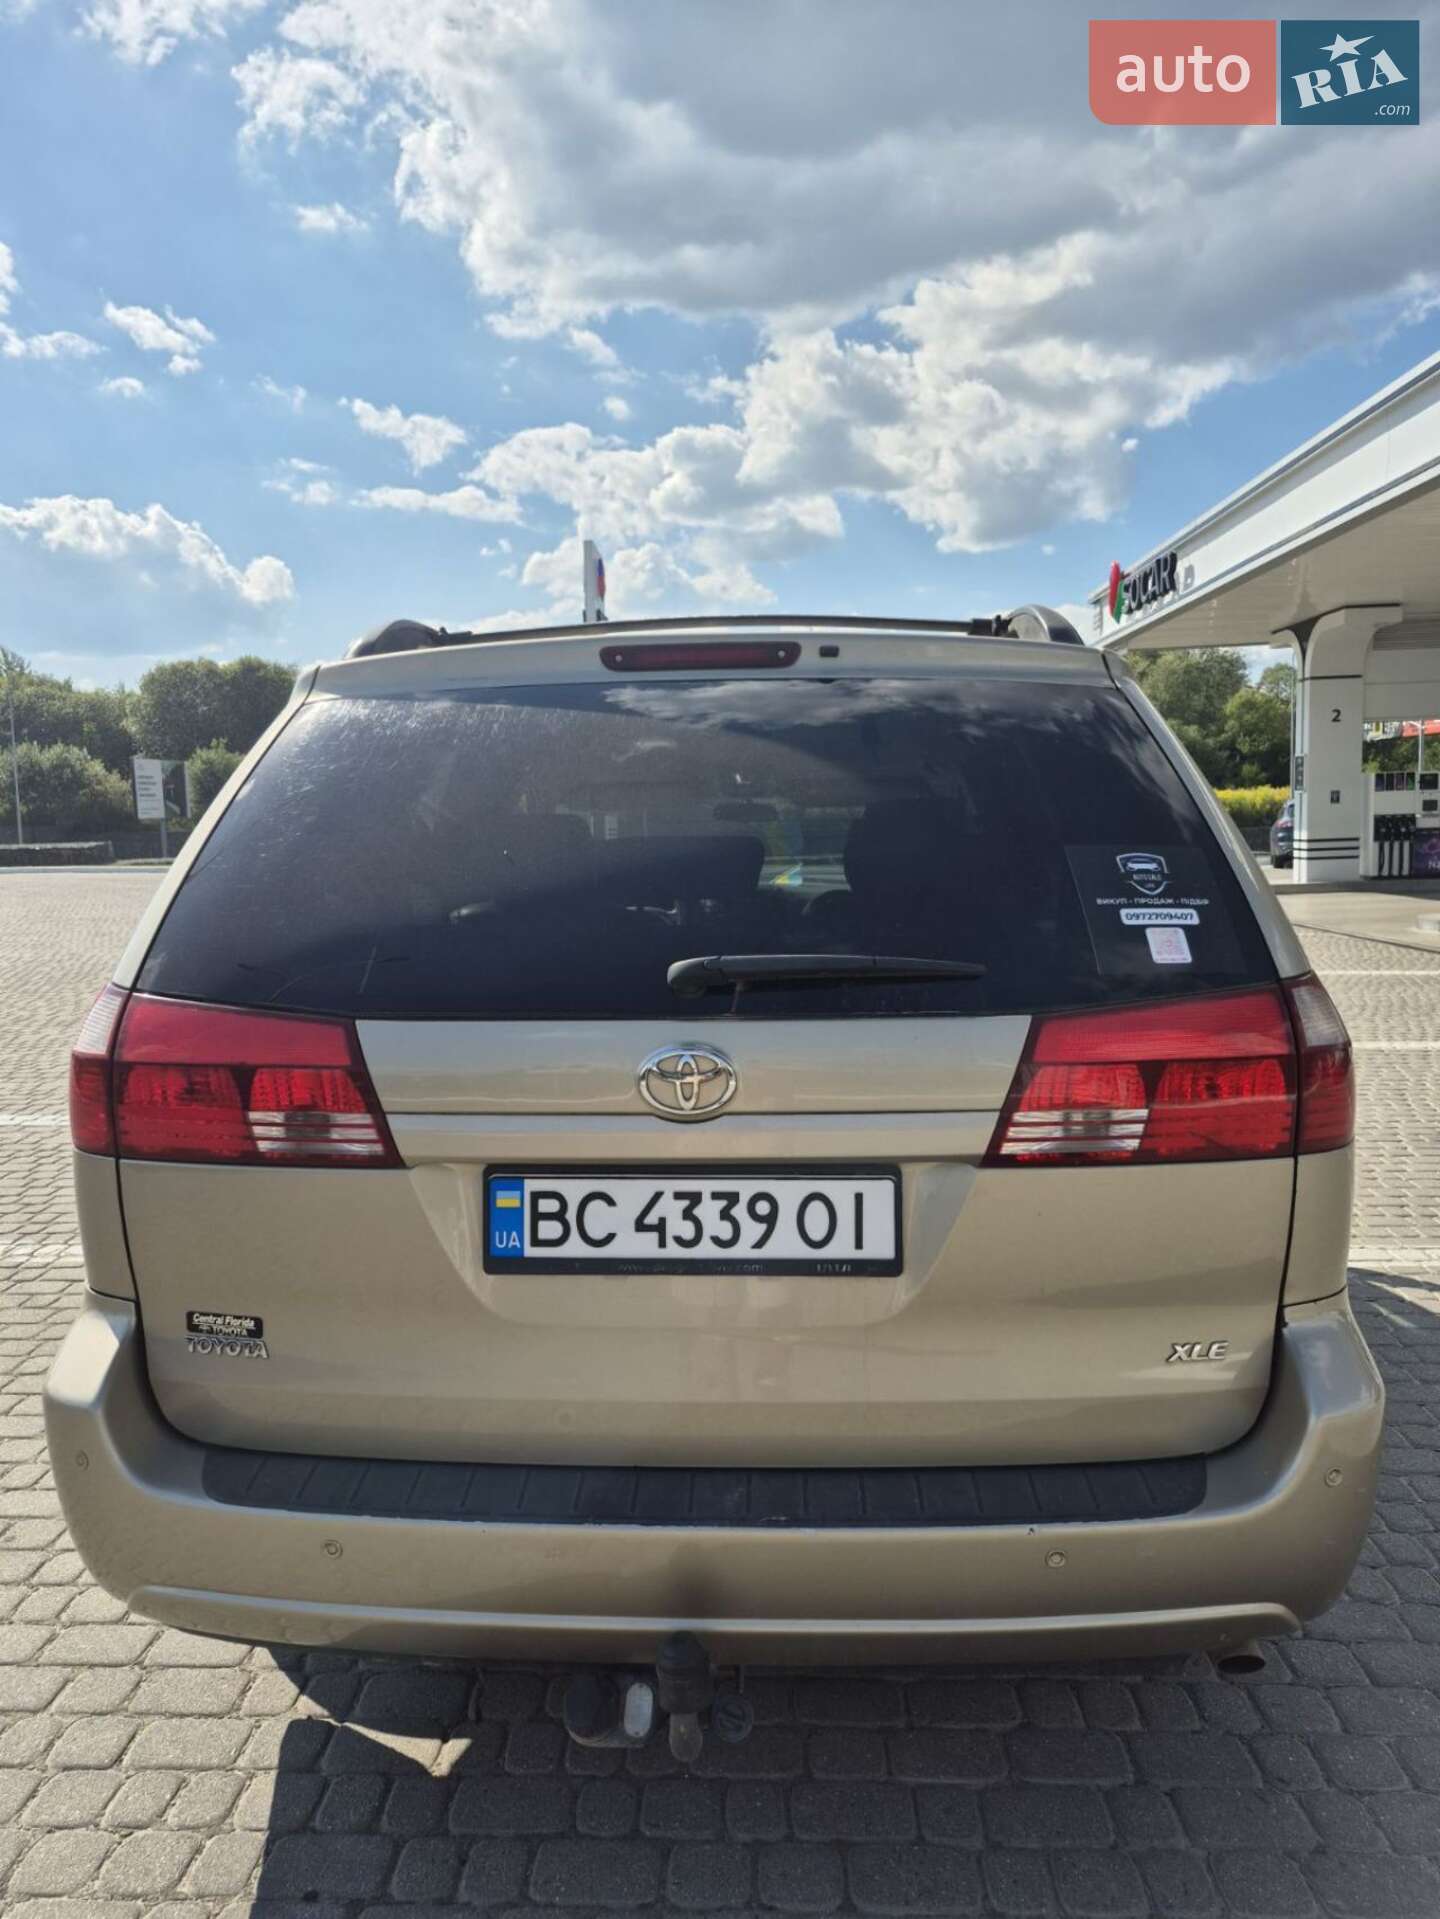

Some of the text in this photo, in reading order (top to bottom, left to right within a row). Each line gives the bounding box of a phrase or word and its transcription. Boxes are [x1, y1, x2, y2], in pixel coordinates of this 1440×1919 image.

[1331, 709, 1342, 723] 2
[529, 1191, 864, 1251] BC 4339 OI
[495, 1231, 521, 1249] UA
[192, 1313, 224, 1324] Central
[185, 1335, 269, 1359] TOYOTA
[1166, 1340, 1229, 1362] XLE
